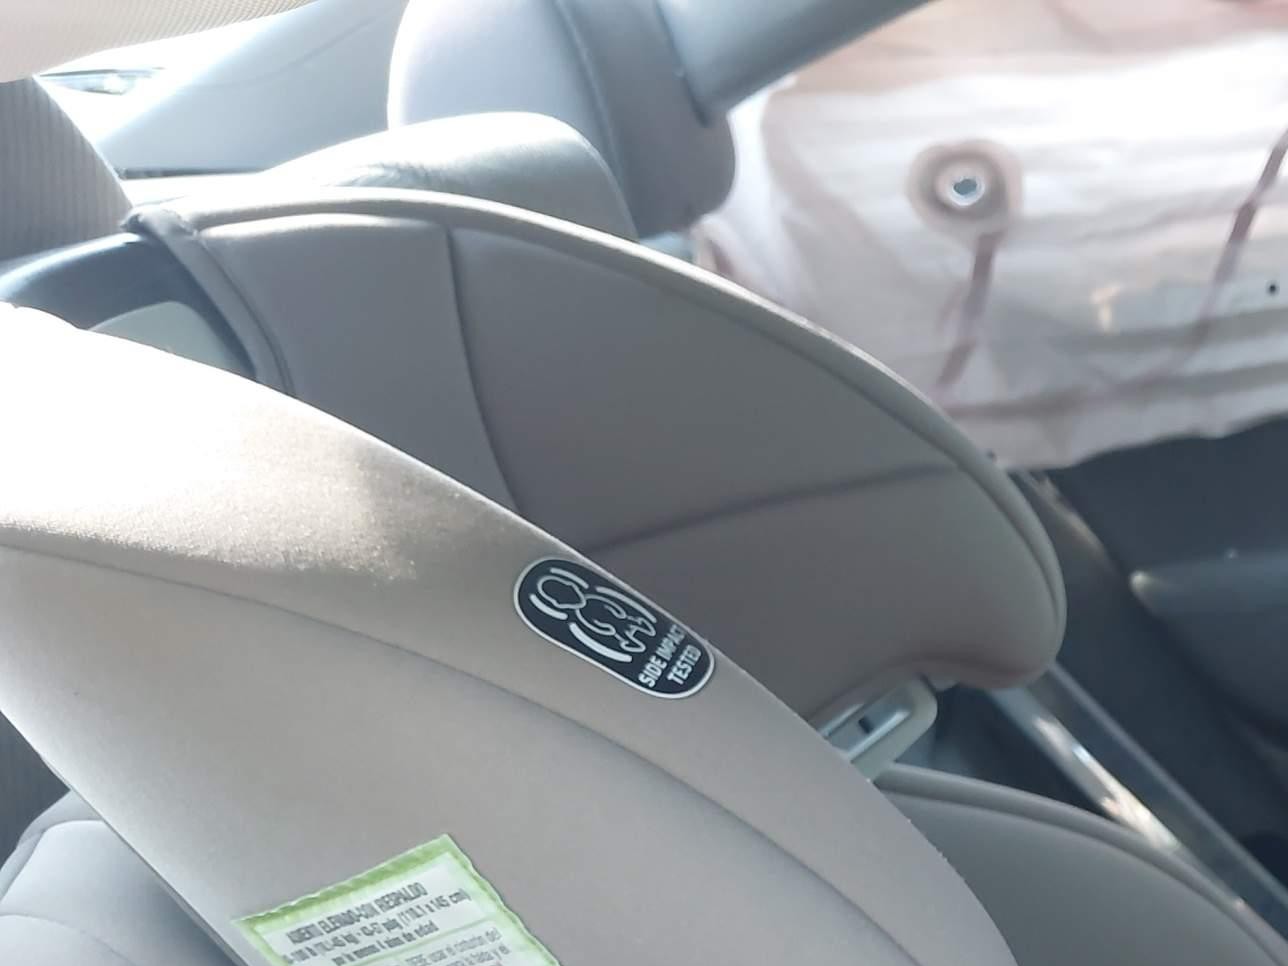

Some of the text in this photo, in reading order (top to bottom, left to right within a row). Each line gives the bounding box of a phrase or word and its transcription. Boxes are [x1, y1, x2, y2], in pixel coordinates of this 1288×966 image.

[638, 624, 685, 688] SIDE IMPACT
[668, 644, 702, 685] TESTED
